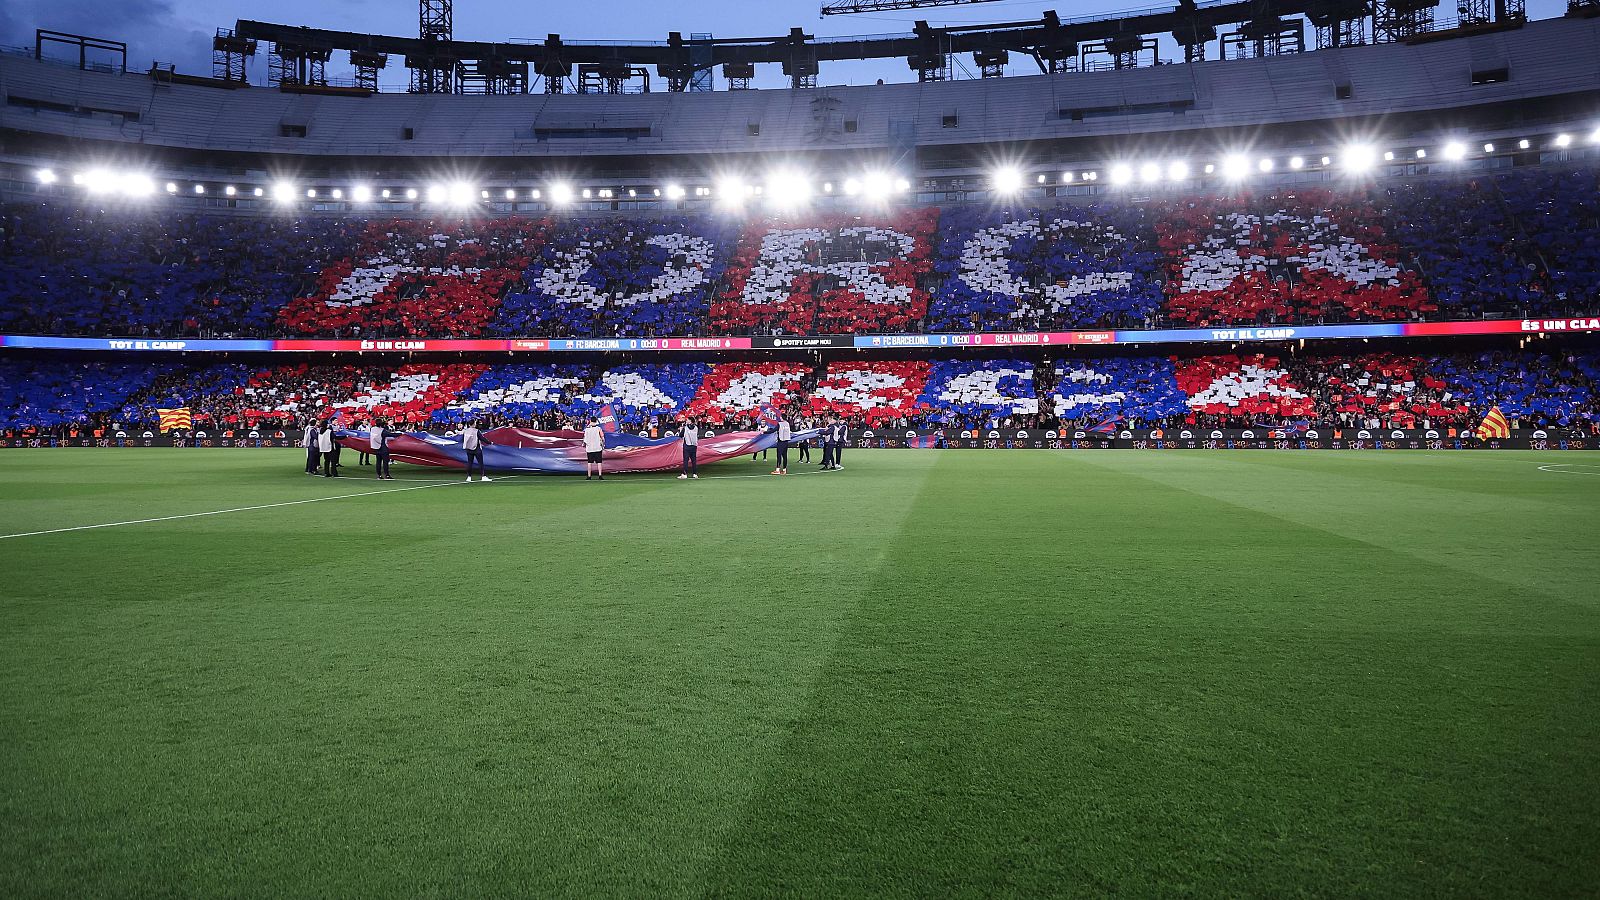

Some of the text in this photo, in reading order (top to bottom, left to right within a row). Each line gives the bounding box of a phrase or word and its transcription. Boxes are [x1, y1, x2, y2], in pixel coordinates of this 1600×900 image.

[1521, 319, 1540, 331] ÉS
[1543, 320, 1566, 330] UN
[1212, 328, 1295, 339] TOT EL CAMP
[883, 336, 928, 345] FC BARCELONA
[952, 335, 970, 344] 00:00
[996, 334, 1039, 344] REAL MADRID
[109, 341, 186, 350] TOT EL CAMP
[360, 339, 426, 350] ÉS UN CLAM
[576, 340, 620, 349] FC BARCELONA
[640, 340, 658, 349] 00:00
[681, 340, 721, 348] REAL MADRID
